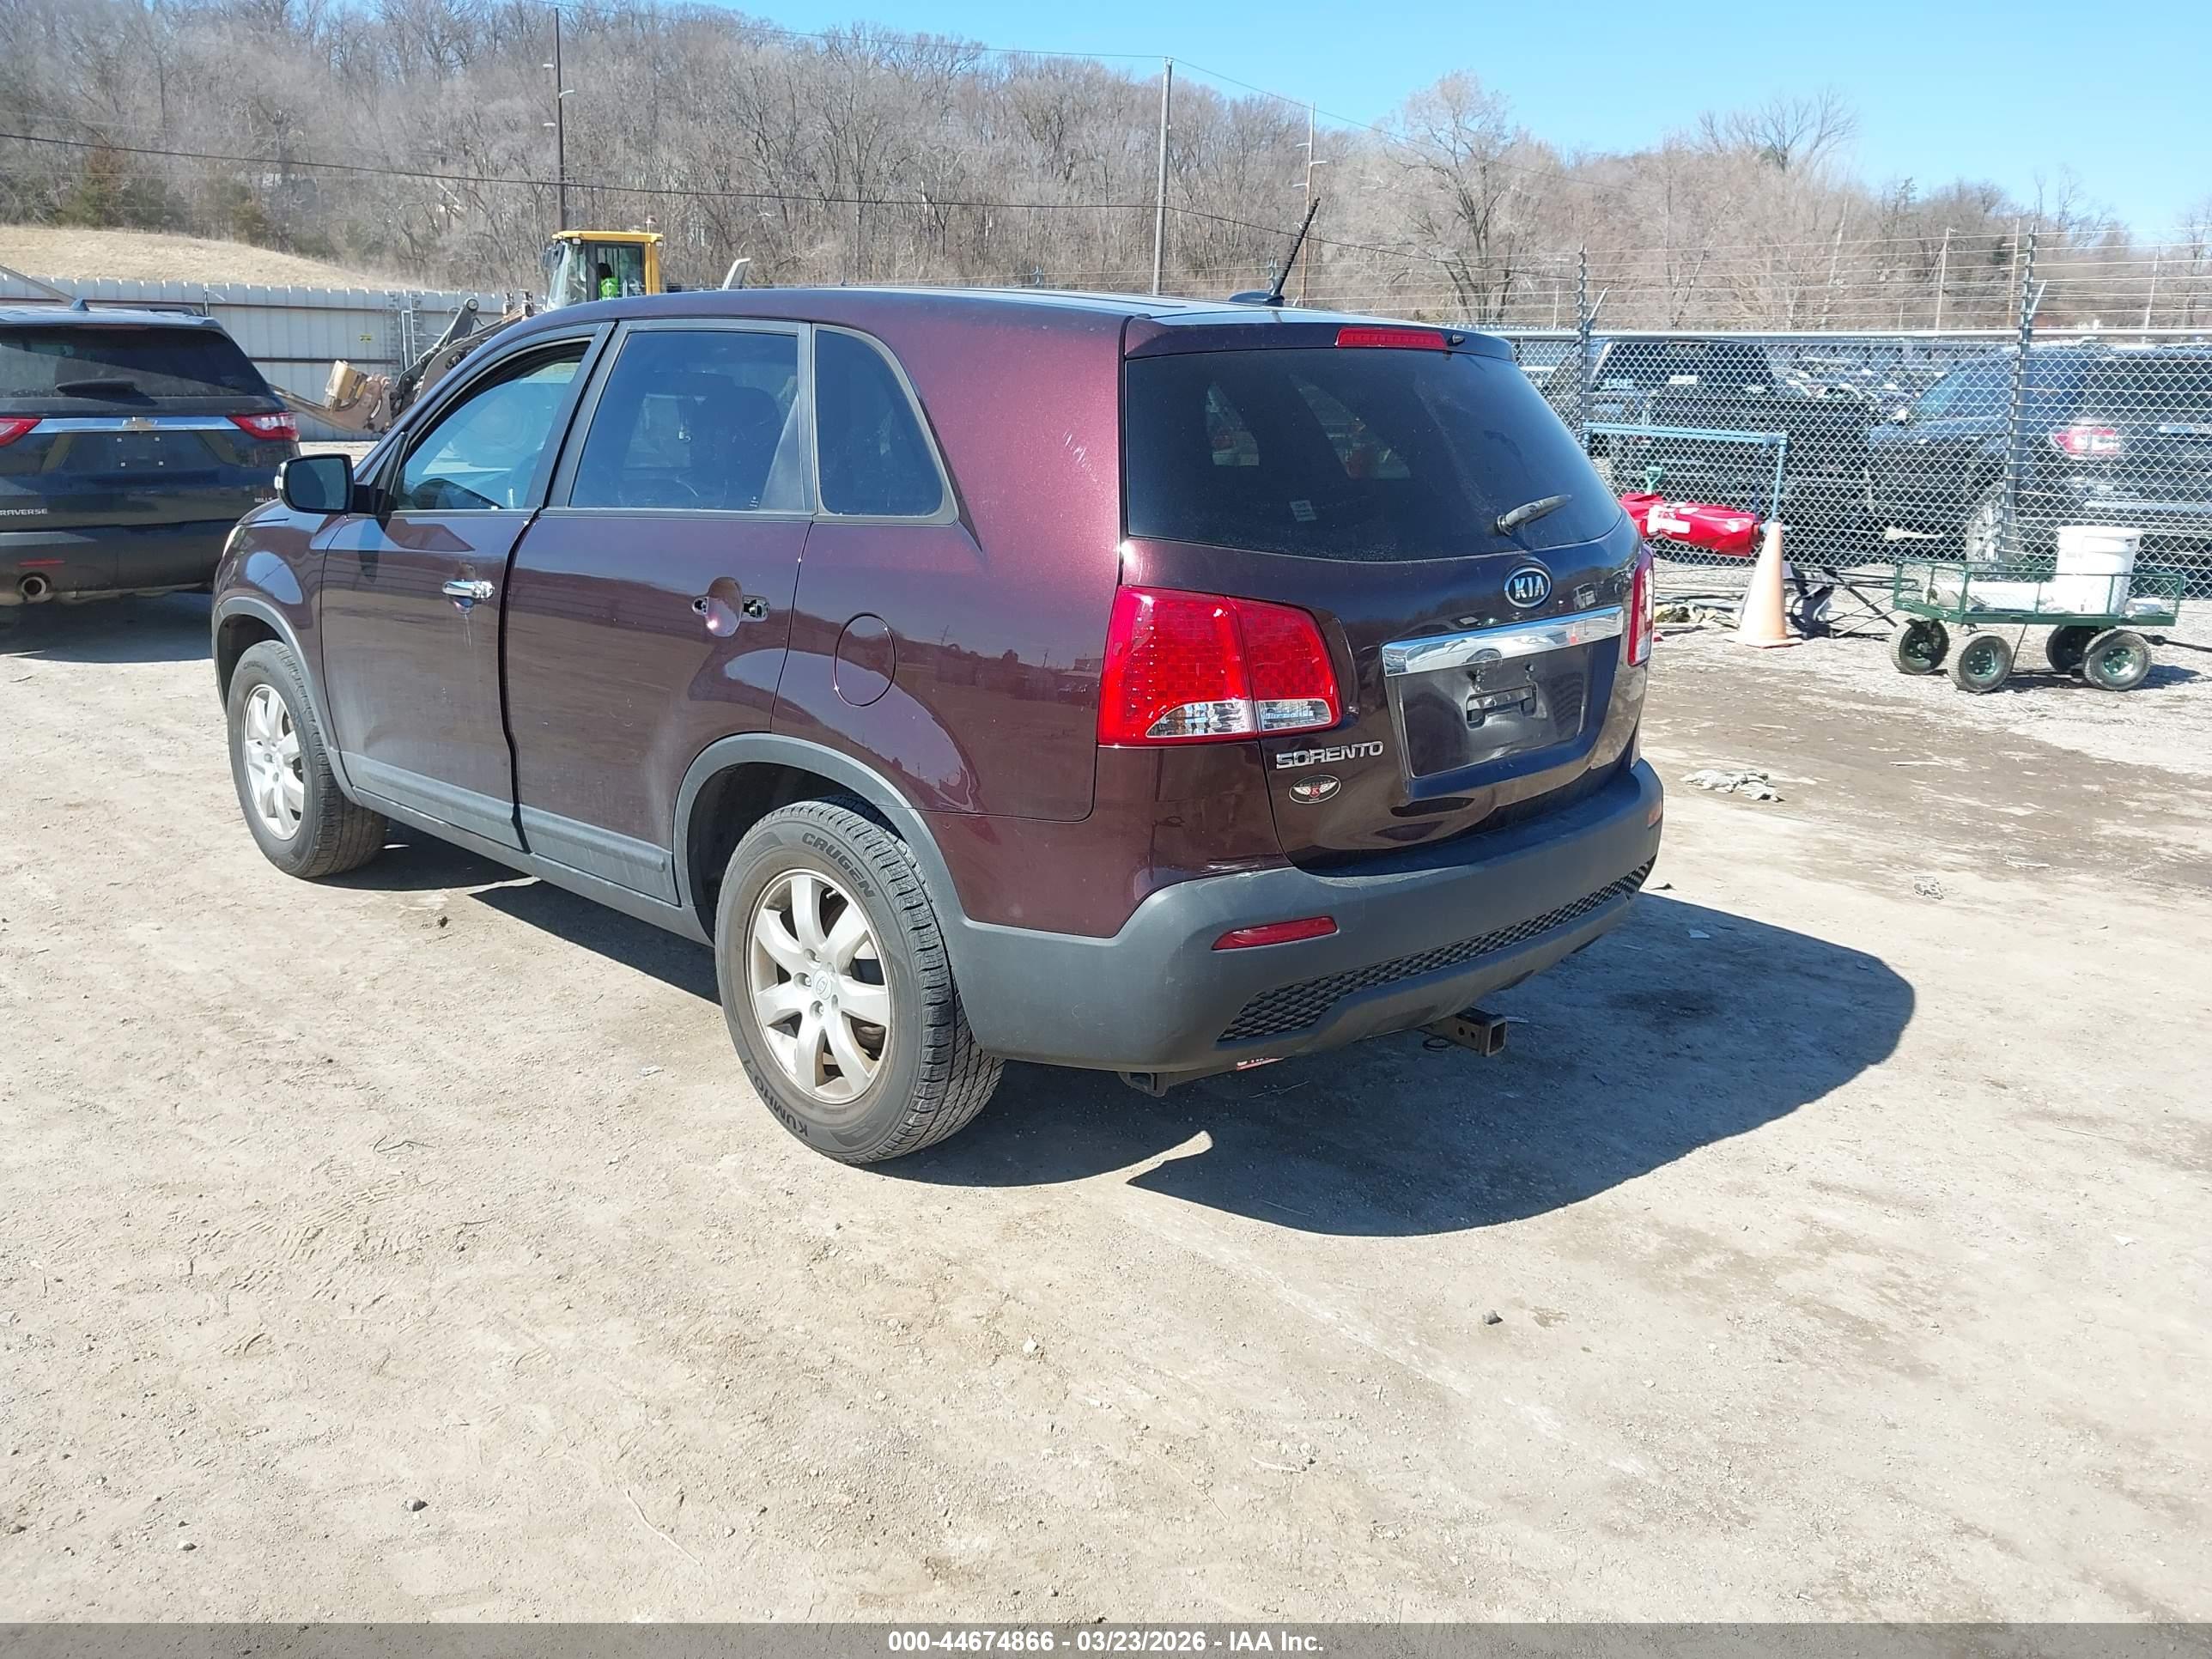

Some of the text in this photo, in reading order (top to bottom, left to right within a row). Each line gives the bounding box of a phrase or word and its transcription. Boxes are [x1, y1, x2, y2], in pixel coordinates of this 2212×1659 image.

[1514, 575, 1545, 599] KIA
[1276, 740, 1384, 769] SORENTO
[802, 832, 876, 898] CRUGEN
[754, 1075, 809, 1138] KUMHO
